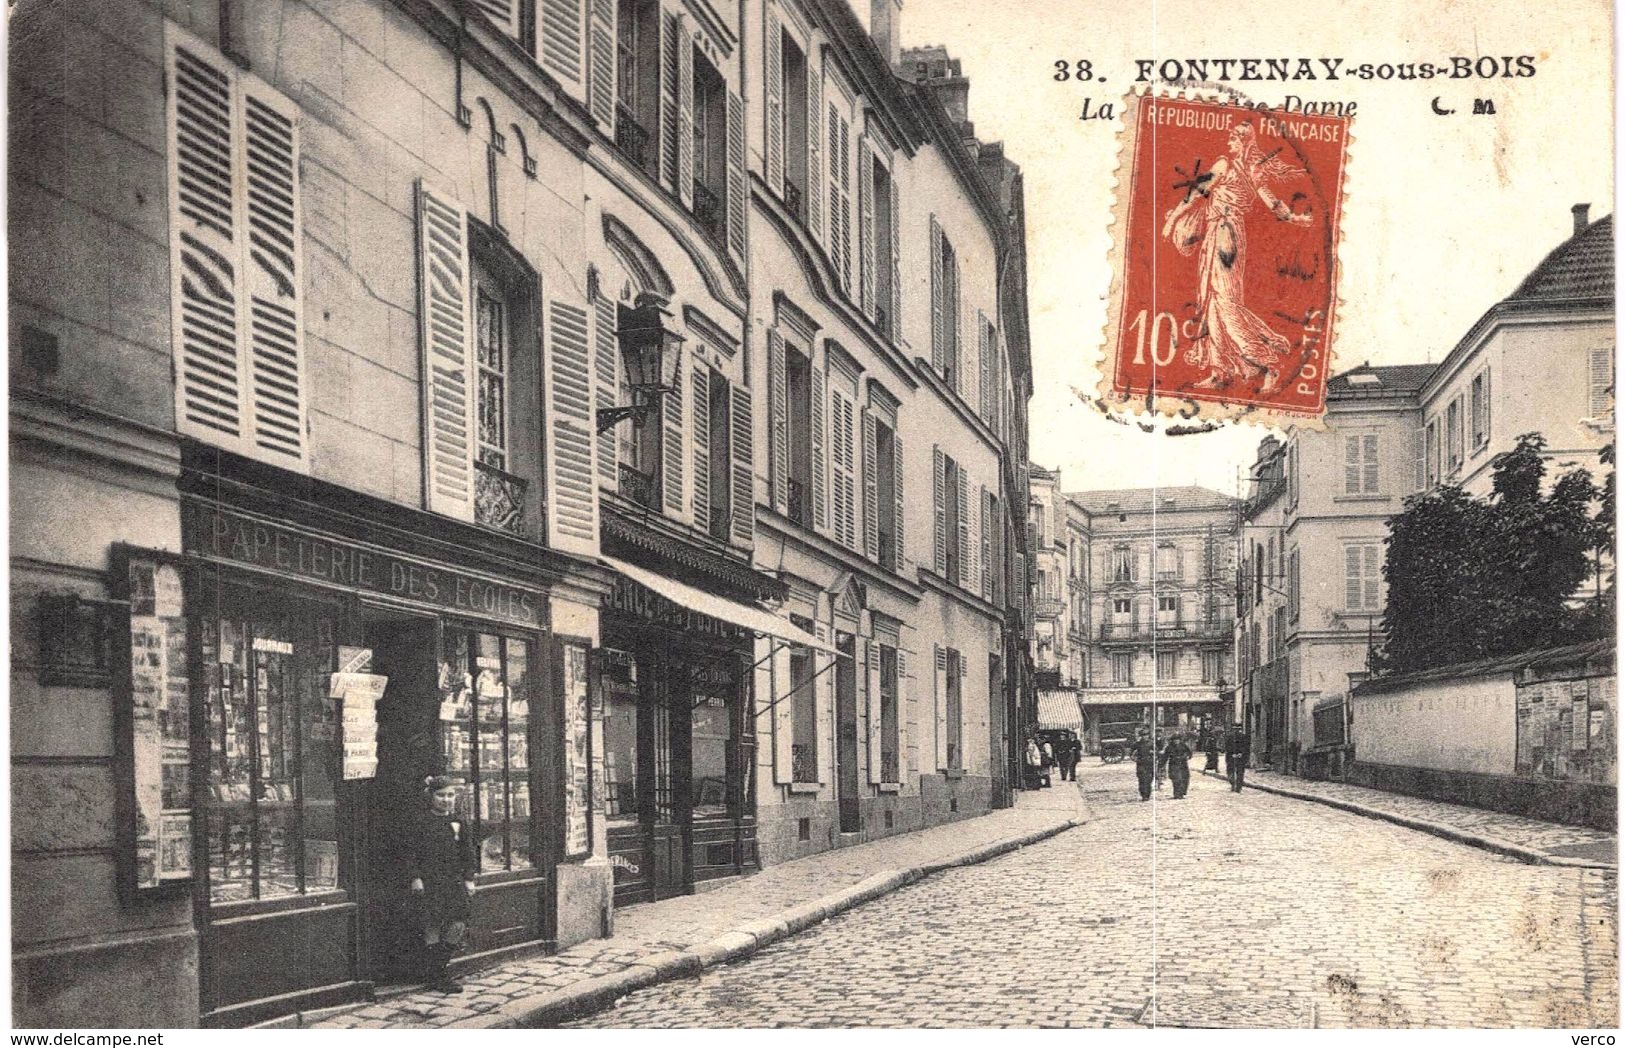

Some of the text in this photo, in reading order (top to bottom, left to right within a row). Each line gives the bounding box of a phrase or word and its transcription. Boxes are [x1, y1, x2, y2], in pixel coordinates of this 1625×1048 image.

[211, 514, 532, 622] PAPETERIE DES ECOLES
